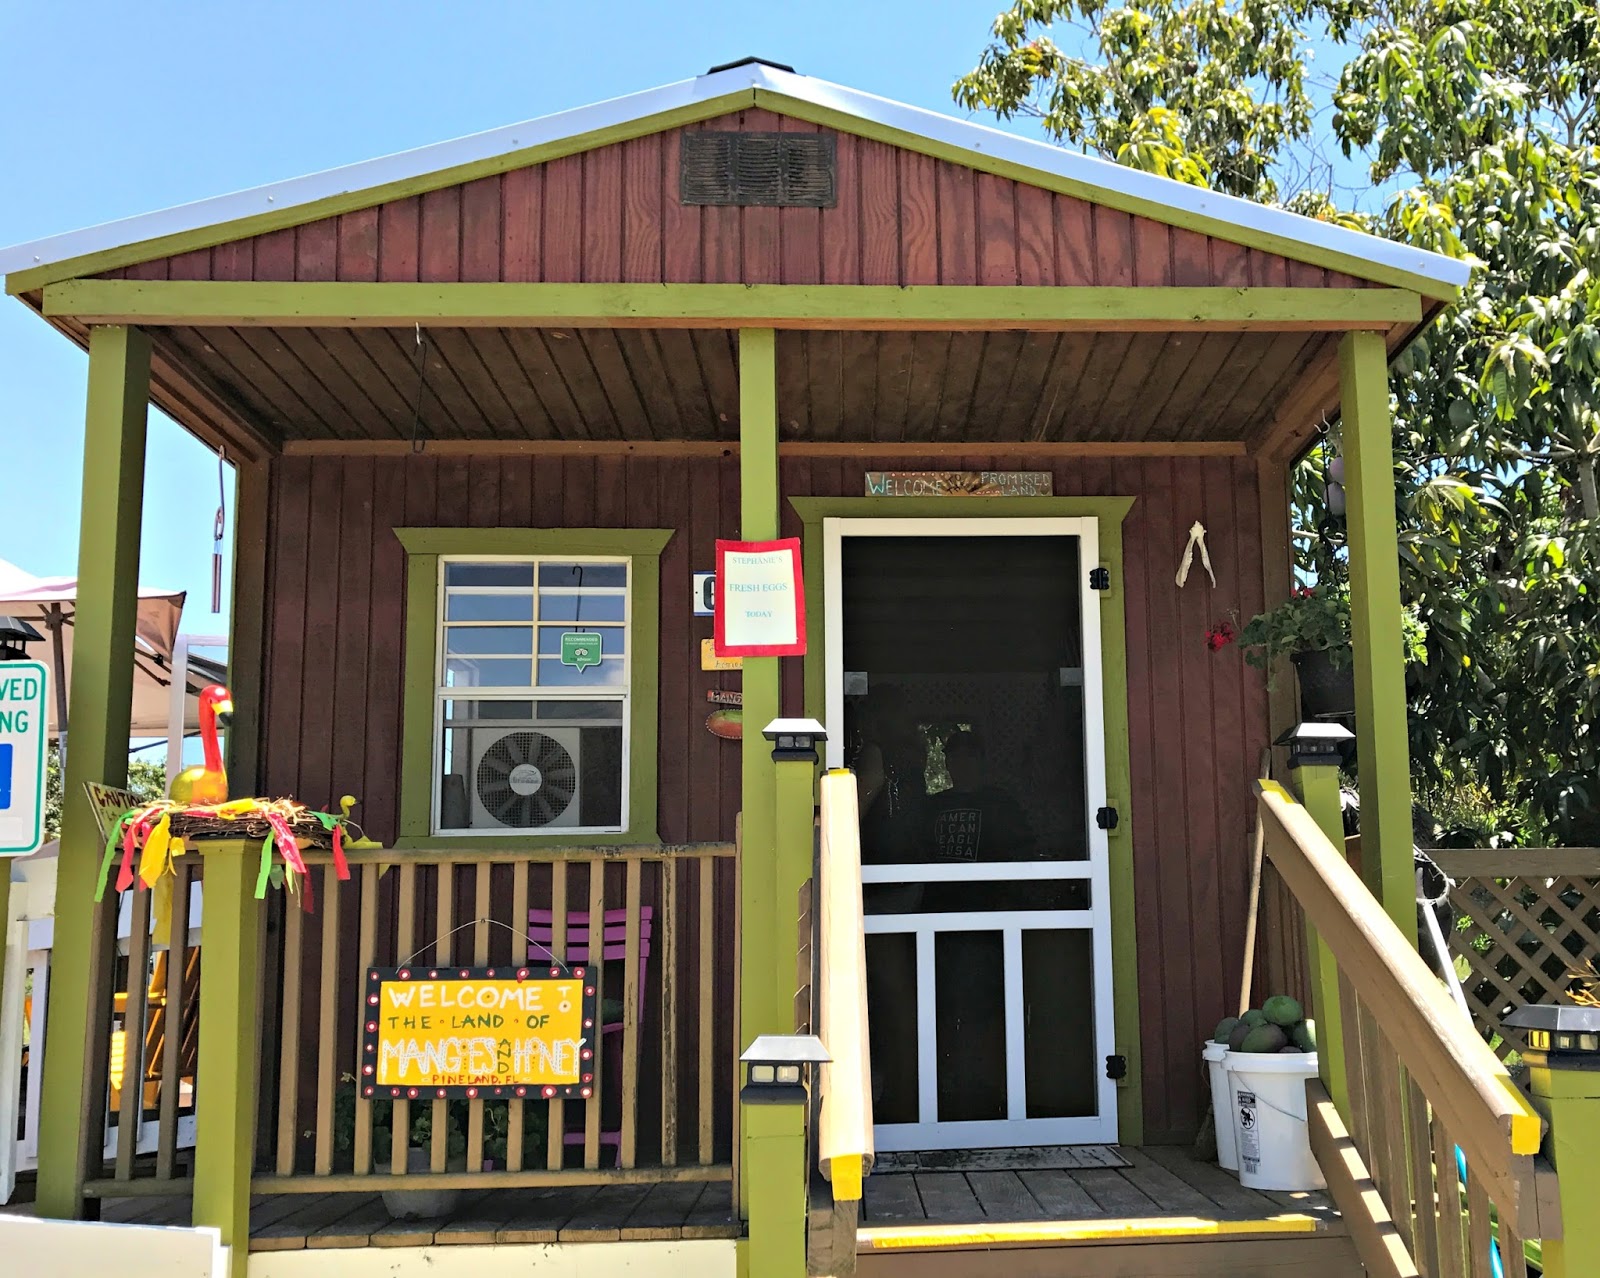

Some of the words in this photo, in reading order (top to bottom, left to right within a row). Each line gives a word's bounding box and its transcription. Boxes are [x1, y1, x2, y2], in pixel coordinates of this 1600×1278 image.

[866, 473, 943, 496] WELCOME
[981, 472, 1051, 487] PROMISED
[1001, 485, 1037, 496] LAND
[732, 556, 783, 565] STEPHANIE'S
[729, 583, 760, 592] FRESH
[762, 582, 788, 592] EGGS
[745, 610, 772, 618] TODAY
[938, 812, 976, 822] AMER
[939, 823, 976, 834] ICAN
[938, 834, 973, 844] EAGL
[388, 985, 543, 1011] WELCOME
[388, 1015, 432, 1029] THE
[452, 1013, 504, 1029] LAND
[526, 1015, 550, 1029] OF
[381, 1037, 497, 1078] MANGOES
[513, 1037, 587, 1077] HONEY
[505, 1074, 519, 1084] FL
